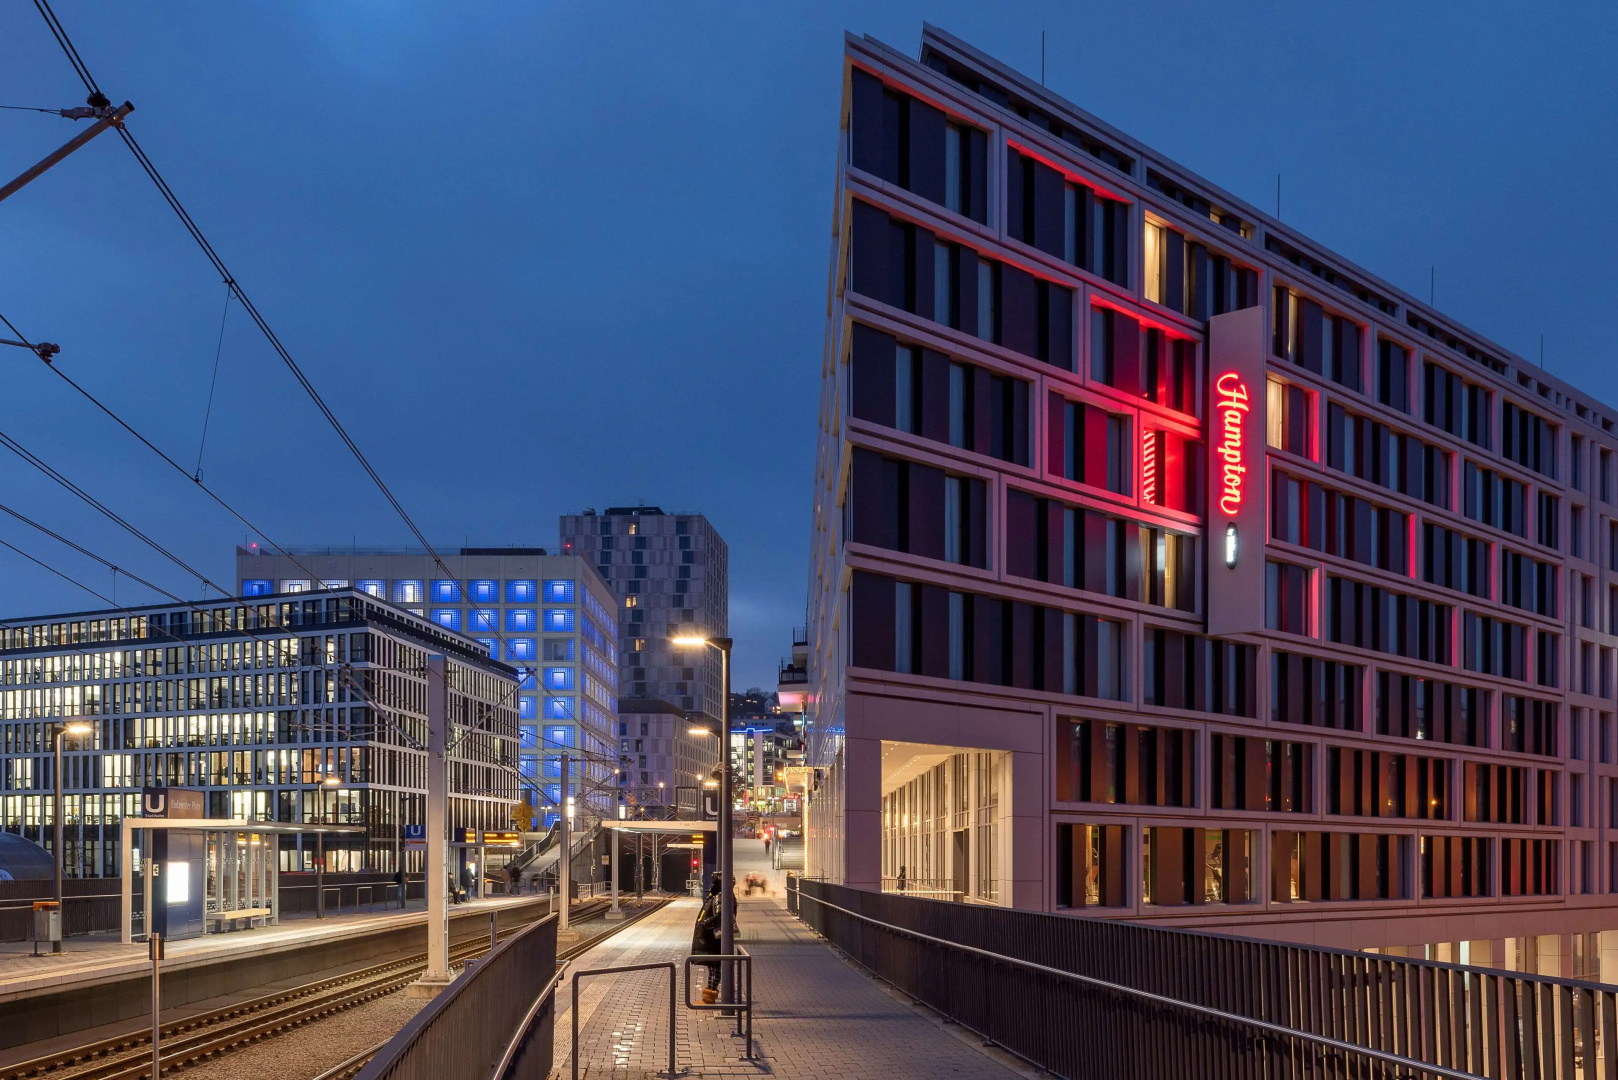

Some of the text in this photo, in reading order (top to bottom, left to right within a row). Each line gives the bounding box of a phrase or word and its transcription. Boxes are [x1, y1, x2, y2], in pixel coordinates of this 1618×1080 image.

[1216, 373, 1249, 514] Hampton
[145, 794, 165, 813] U
[410, 825, 422, 836] U
